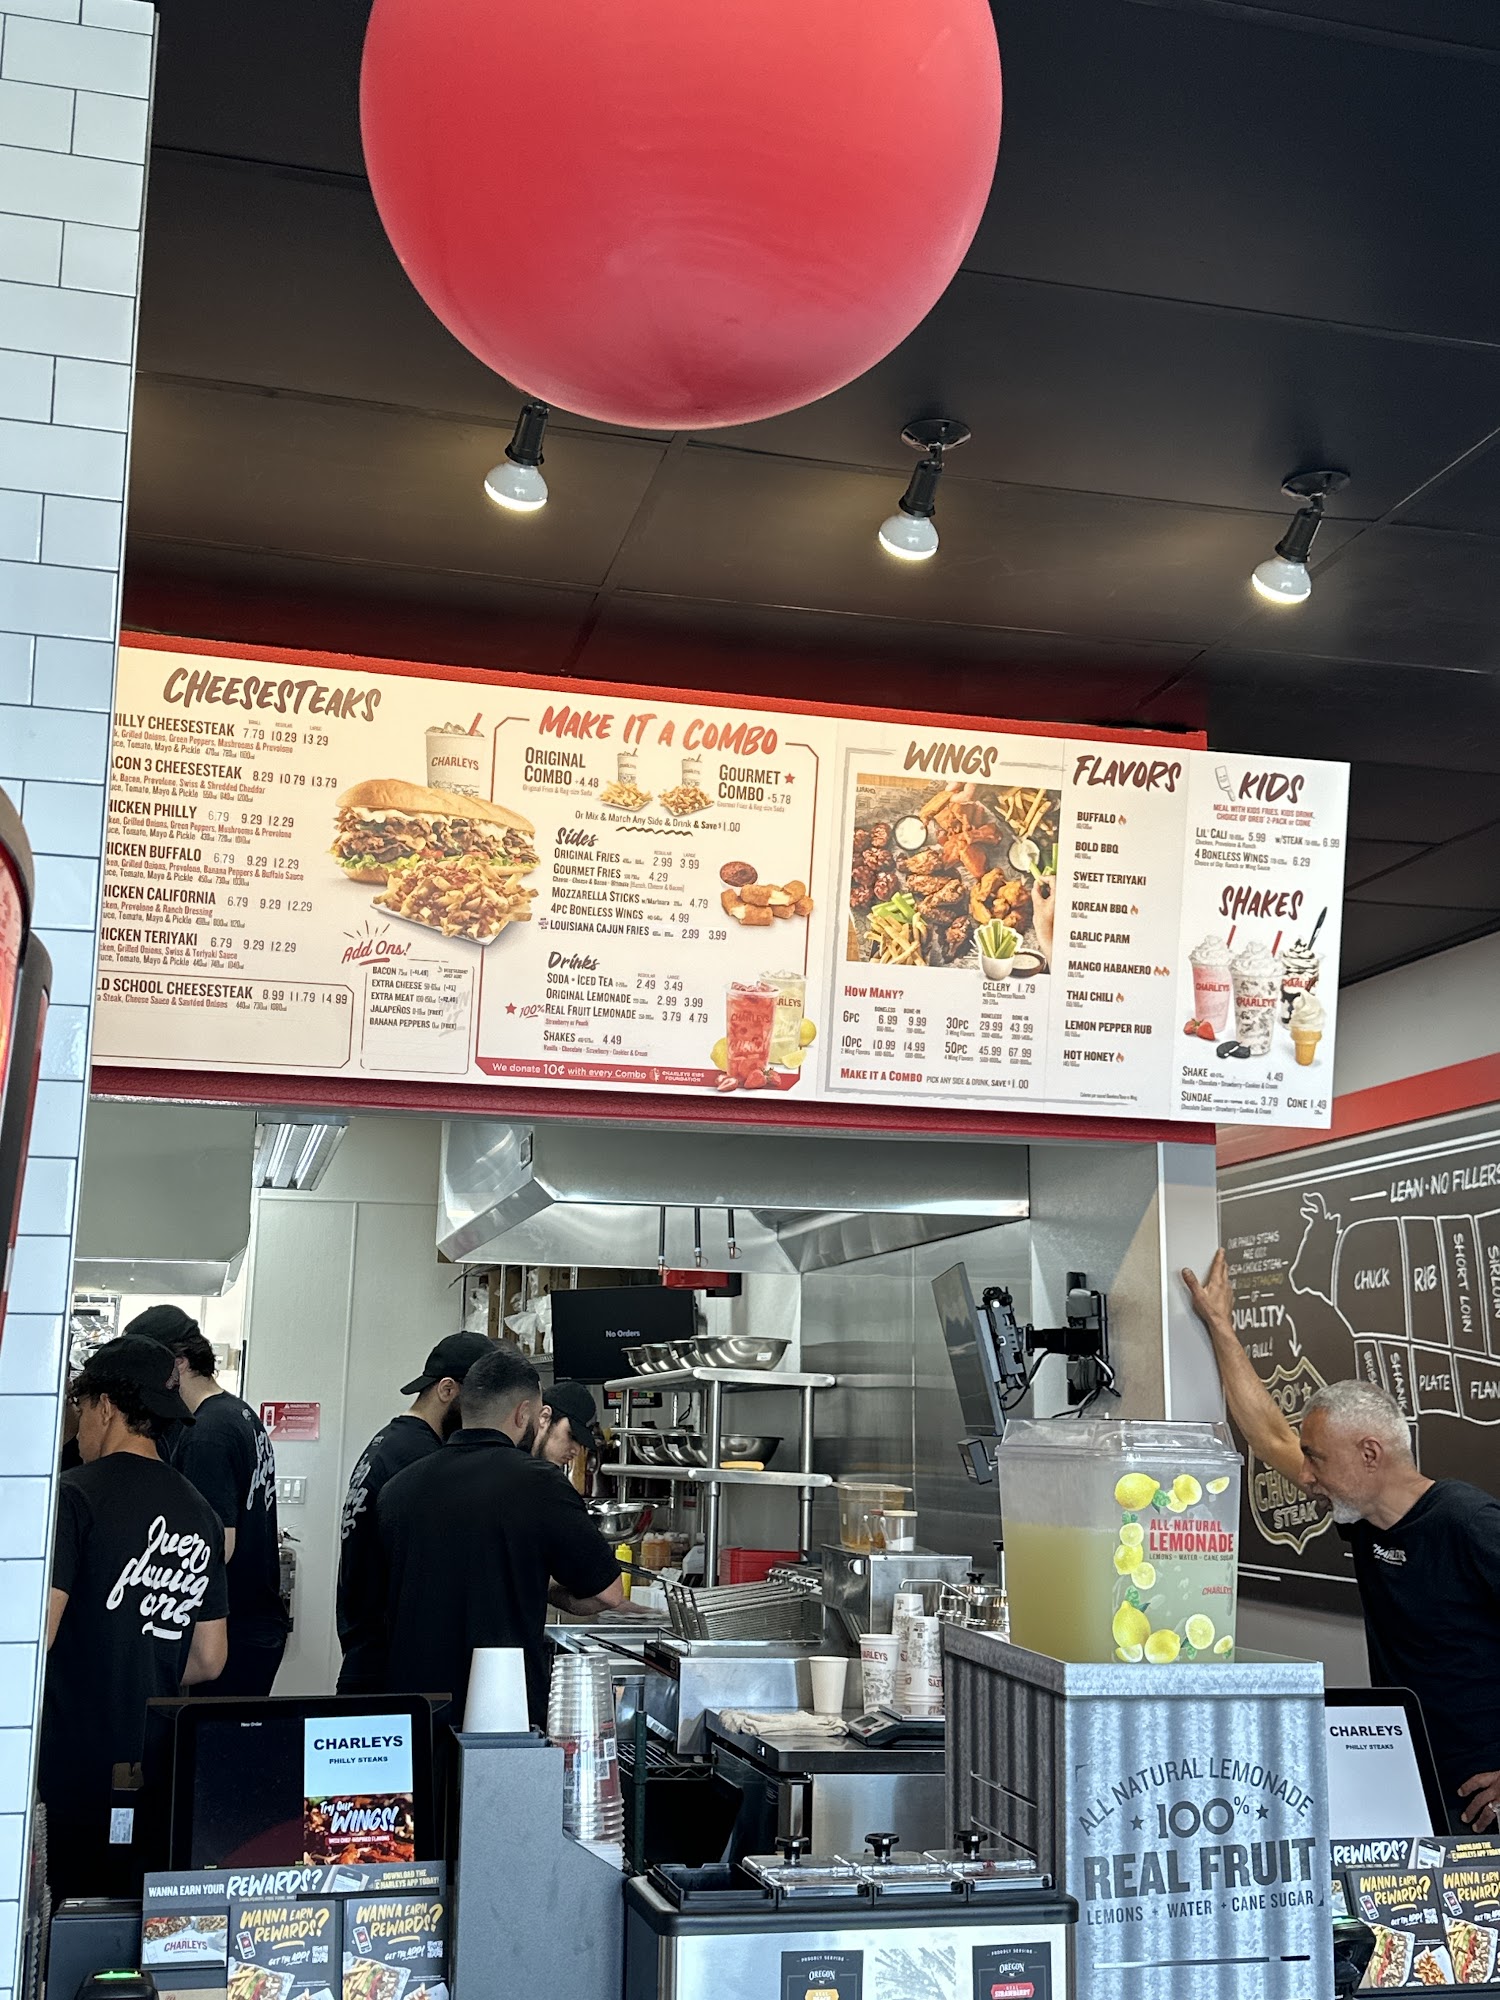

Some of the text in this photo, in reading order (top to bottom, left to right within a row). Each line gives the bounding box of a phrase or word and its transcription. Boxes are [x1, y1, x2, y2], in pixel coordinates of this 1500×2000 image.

[163, 667, 382, 722] CHEESESTEAKS
[148, 716, 235, 737] CHEESESTEAK
[243, 728, 265, 740] 7.79
[271, 730, 297, 743] 10.29
[303, 733, 329, 746] 13.29
[538, 705, 778, 756] MAKE IT A COMBO
[431, 755, 480, 771] CHARLEYS
[524, 747, 586, 786] ORIGINAL COMBO
[903, 740, 998, 777] WINGS
[144, 758, 338, 788] 3 CHEESESTEAK 8.29 10.79 13.79
[718, 764, 781, 801] GOURMET COMBO
[1072, 755, 1182, 792] FLAVORS
[1238, 771, 1305, 804] KIDS
[153, 803, 198, 819] PHILLY
[575, 810, 584, 820] Or
[585, 811, 599, 821] Mix
[600, 813, 607, 822] &
[608, 813, 631, 823] Match
[632, 815, 646, 826] Any
[647, 816, 663, 825] Side
[664, 818, 671, 826] &
[672, 818, 692, 828] Drink
[693, 820, 699, 828] &
[700, 820, 717, 830] Save
[1076, 811, 1116, 824] BUFFALO
[555, 826, 599, 847] Sides
[149, 845, 299, 870] BUFFALO 6.79 9.29 12.29
[554, 847, 594, 861] ORIGINAL
[596, 850, 620, 863] FRIES
[653, 857, 673, 868] 2.99
[680, 859, 700, 870] 3.99
[1194, 848, 1269, 864] 4 BONELESS WINGS
[553, 863, 668, 883] GOURMET FRIES 4.29
[1073, 871, 1146, 887] SWEET TERIYAKI
[147, 887, 216, 905] CALIFORNIA
[551, 887, 709, 909] MOZZARELLA STICKS 4.79
[1218, 885, 1304, 921] SHAKES
[550, 902, 690, 924] 4PC BONELESS WINGS 4.99
[550, 919, 594, 933] LOUISIANA
[596, 922, 624, 935] CAJUN
[626, 924, 650, 936] FRIES
[144, 930, 198, 946] TERIYAKI
[1070, 931, 1130, 945] GARLIC PARM
[341, 940, 412, 964] Add Ons!
[547, 951, 600, 971] Drinks
[372, 966, 396, 975] BACON
[113, 978, 348, 1005] SCHOOL CHEESESTEAK 8.99 11.79 14.99
[371, 979, 422, 990] EXTRA CHEESE
[546, 972, 683, 992] SODA ICED TEA 2.49 3.49
[546, 987, 631, 1004] ORIGINAL LEMONADE
[844, 985, 904, 1000] HOW MANY?
[519, 1003, 708, 1023] 100% REAL FRUIT LEMONADE 3.79 4.79
[842, 1010, 860, 1023] 6PC
[946, 1017, 969, 1030] 30PC
[1065, 1020, 1152, 1035] LEMON PEPPER RUB
[543, 1030, 622, 1045] SHAKES 4.49
[1063, 1049, 1115, 1063] HOT HONEY
[492, 1062, 646, 1079] We donate 10¢ with every Combo
[1390, 1177, 1423, 1203] LEAN
[1431, 1171, 1450, 1195] NO
[1354, 1267, 1390, 1291] CHUCK
[1414, 1264, 1437, 1292] RIB
[605, 1329, 640, 1338] No Orders
[1419, 1374, 1450, 1392] PLATE
[1150, 1518, 1222, 1532] ALL-NATURAL
[1273, 1501, 1319, 1530] STEAK
[1149, 1533, 1234, 1553] LEMONADE
[1329, 1725, 1403, 1737] CHARLEYS
[313, 1735, 403, 1751] CHARLEYS
[1078, 1757, 1315, 1836] ALL NATURAL LEMONADE
[320, 1800, 354, 1817] Try Our
[1156, 1796, 1250, 1839] 100%
[330, 1806, 399, 1834] WINGS!
[1333, 1840, 1408, 1866] REWARDS?
[1083, 1837, 1316, 1901] REAL FRUIT
[148, 1886, 179, 1898] WANNA
[179, 1885, 201, 1896] EARN
[202, 1883, 225, 1895] YOUR
[226, 1868, 323, 1899] REWARDS?
[1359, 1875, 1417, 1894] WANNA EARN
[1373, 1875, 1431, 1907] REWARDS?
[356, 1903, 427, 1924] WANNA EARN
[1087, 1889, 1314, 1925] LEMONS WATER CANE SUGAR
[370, 1903, 444, 1940] REWARDS?
[808, 1969, 835, 1981] OREGON
